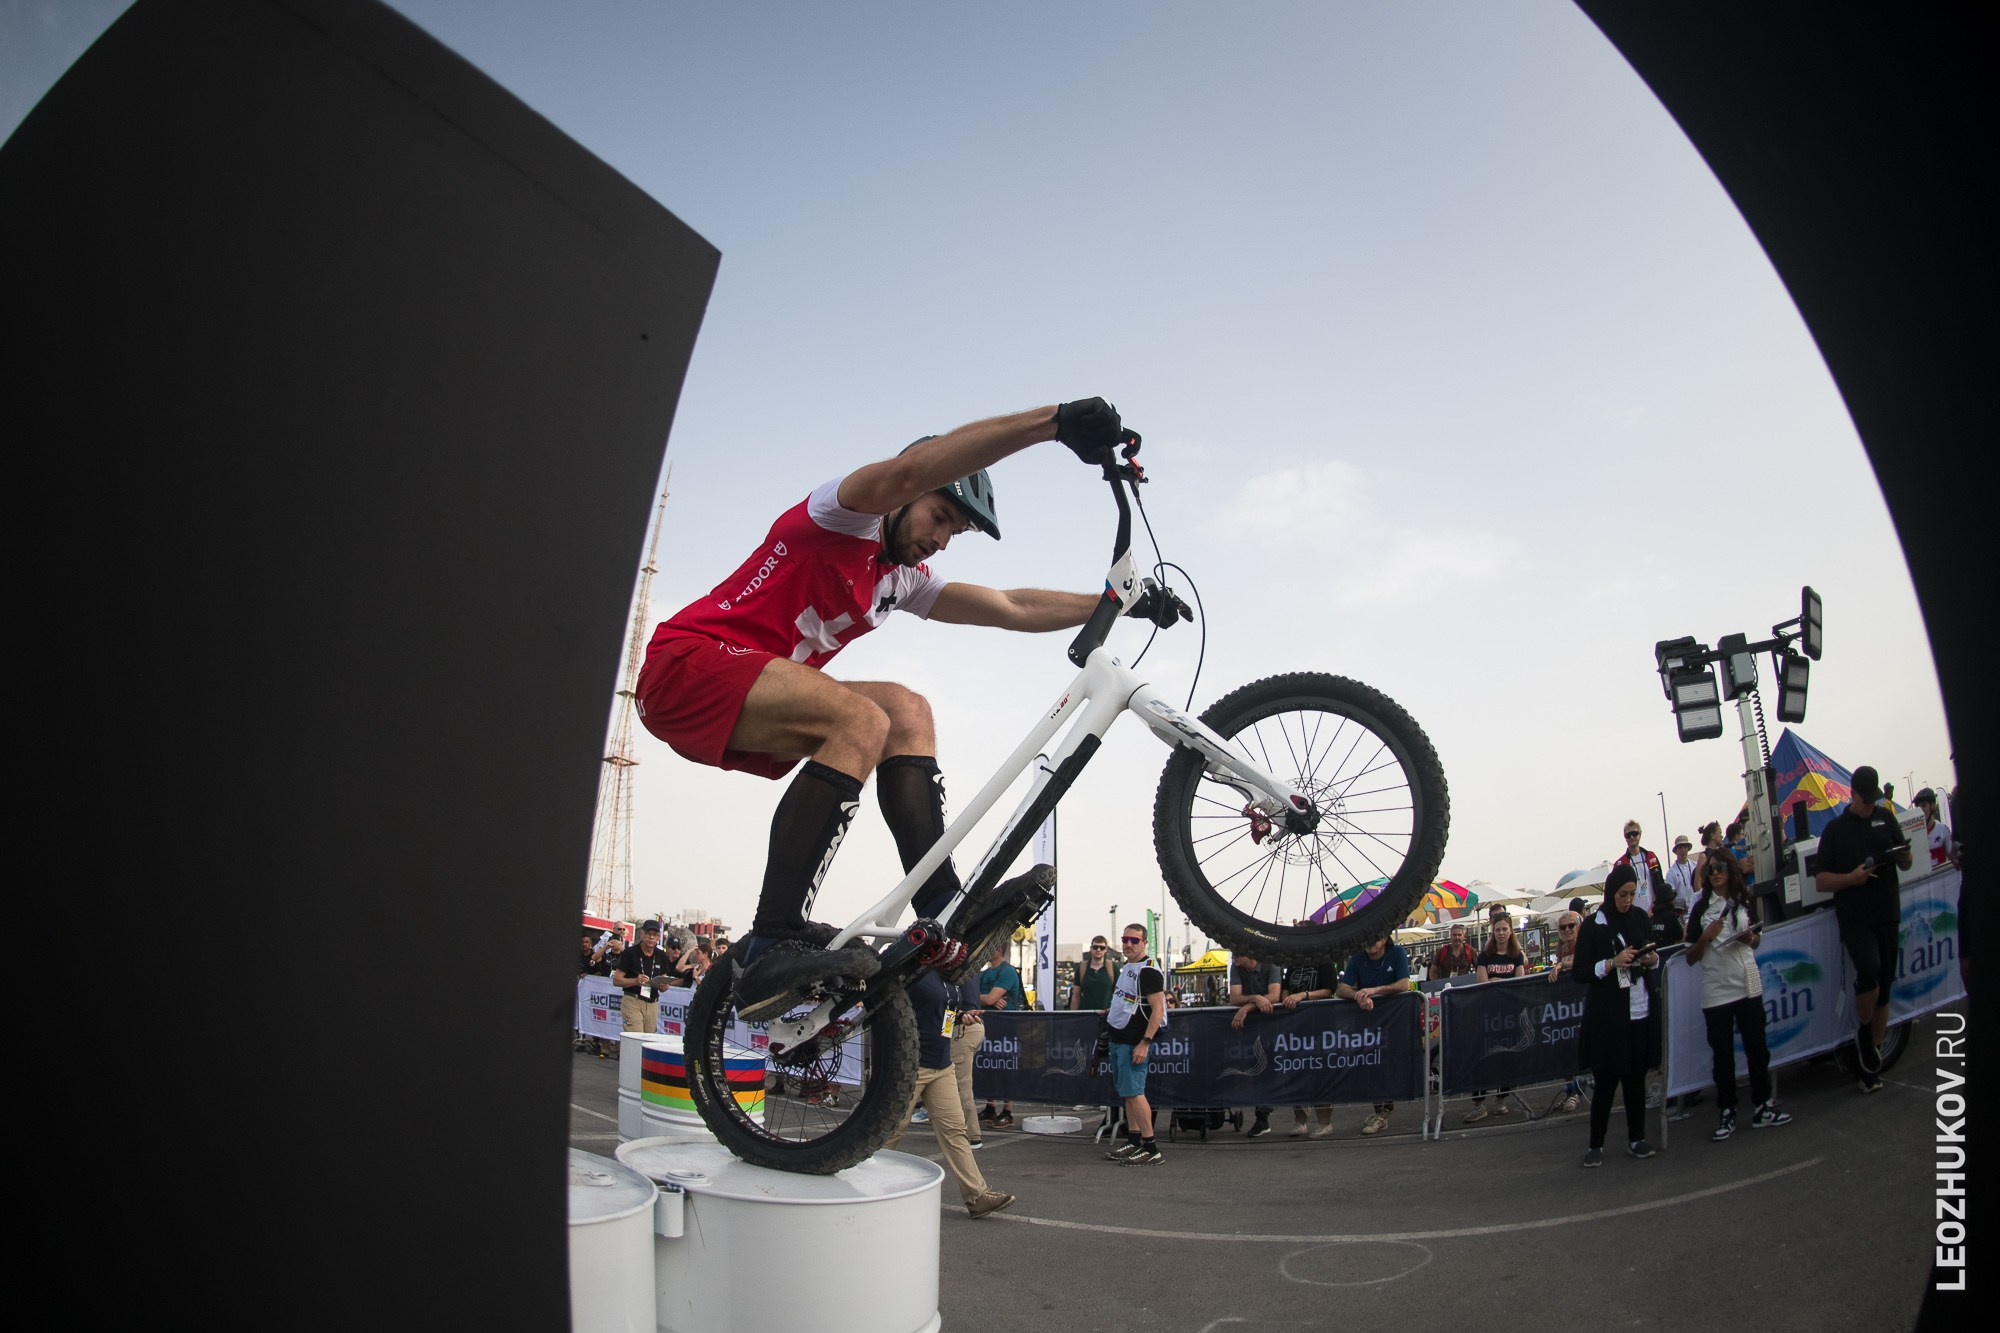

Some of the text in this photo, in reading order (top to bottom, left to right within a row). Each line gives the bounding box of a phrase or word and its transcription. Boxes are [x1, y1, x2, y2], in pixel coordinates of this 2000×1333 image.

[1776, 758, 1806, 788] Red
[1900, 815, 1925, 828] ENERAC
[1910, 936, 1954, 975] ain
[593, 994, 608, 1007] UCI
[1763, 987, 1815, 1026] ain
[664, 1005, 682, 1019] UCI
[1542, 1001, 1583, 1023] Abu
[1274, 1033, 1314, 1052] Abu
[1322, 1027, 1382, 1050] Dhabi
[975, 1055, 1018, 1071] Council
[1149, 1058, 1189, 1075] ouncil
[1273, 1049, 1381, 1074] Sports Council
